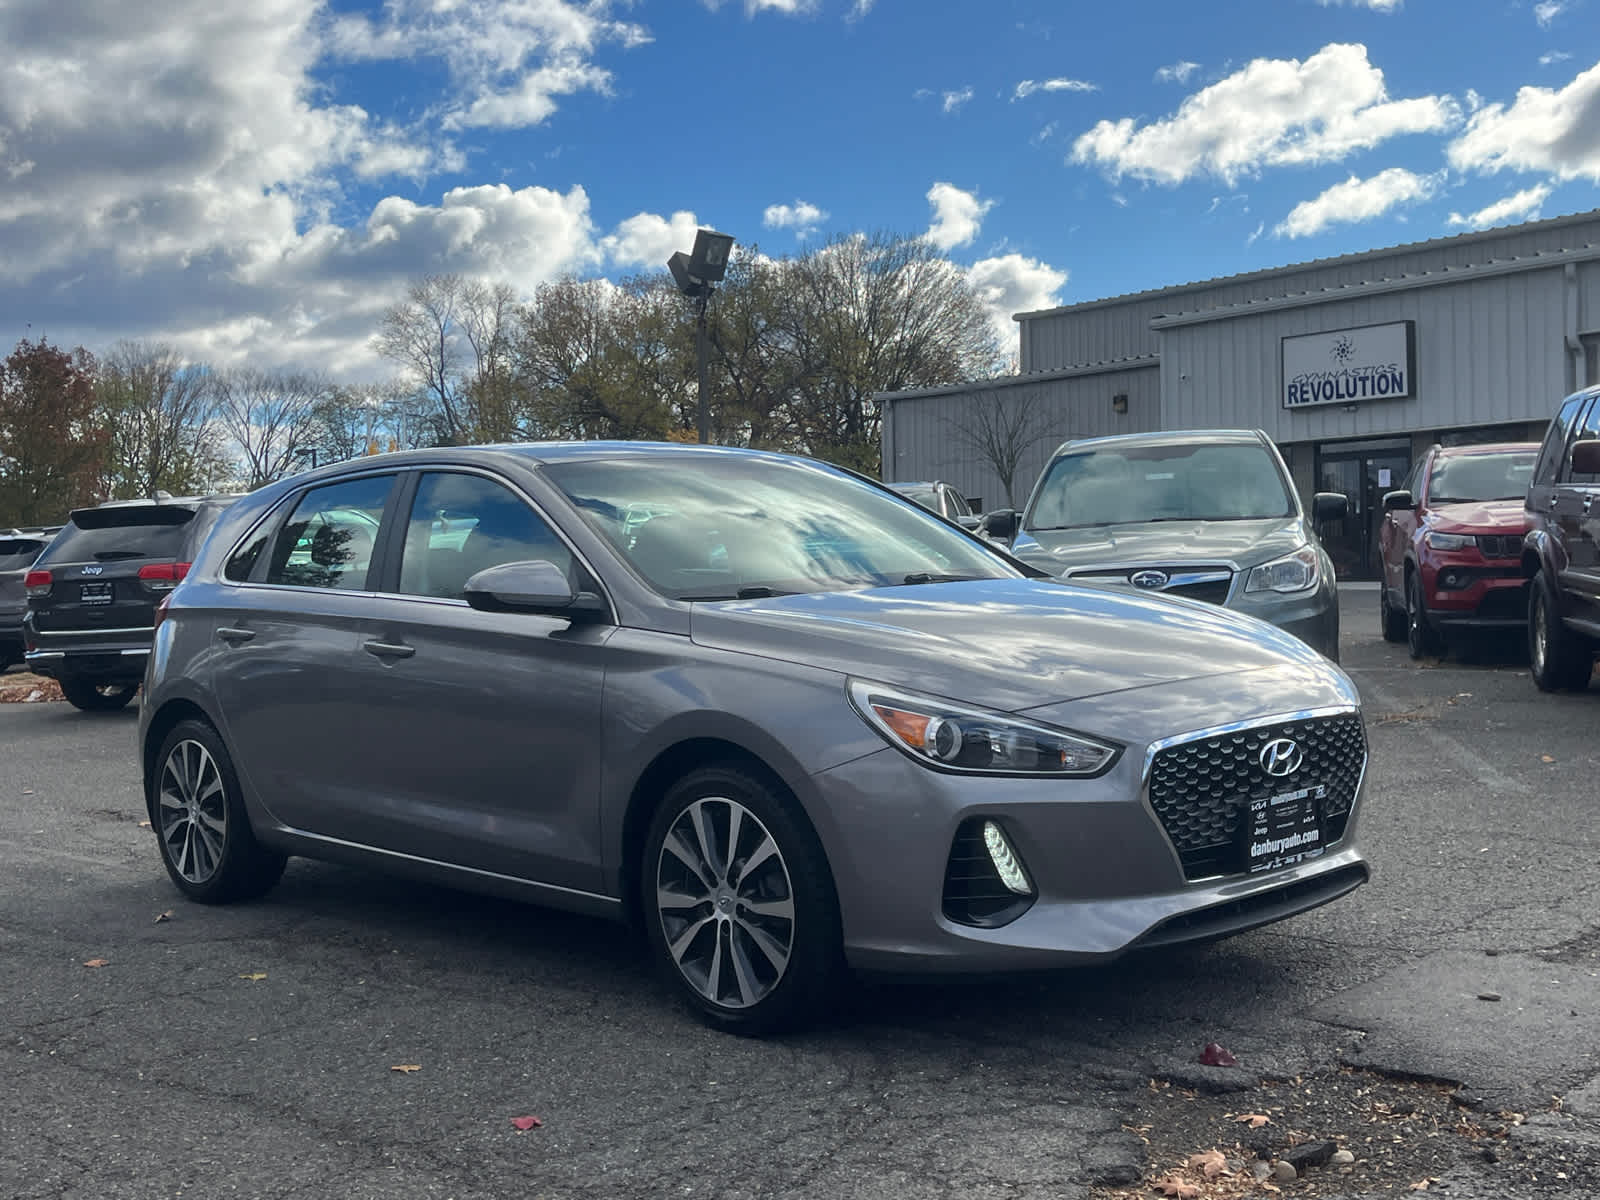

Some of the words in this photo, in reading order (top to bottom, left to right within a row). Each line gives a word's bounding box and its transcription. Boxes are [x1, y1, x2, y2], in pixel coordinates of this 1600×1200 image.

[1293, 363, 1398, 386] GYMNASTICS
[1288, 372, 1404, 404] REVOLUTION
[81, 566, 103, 576] Jeep
[1251, 829, 1319, 857] danburyauto.com
[1254, 827, 1268, 836] Jeep
